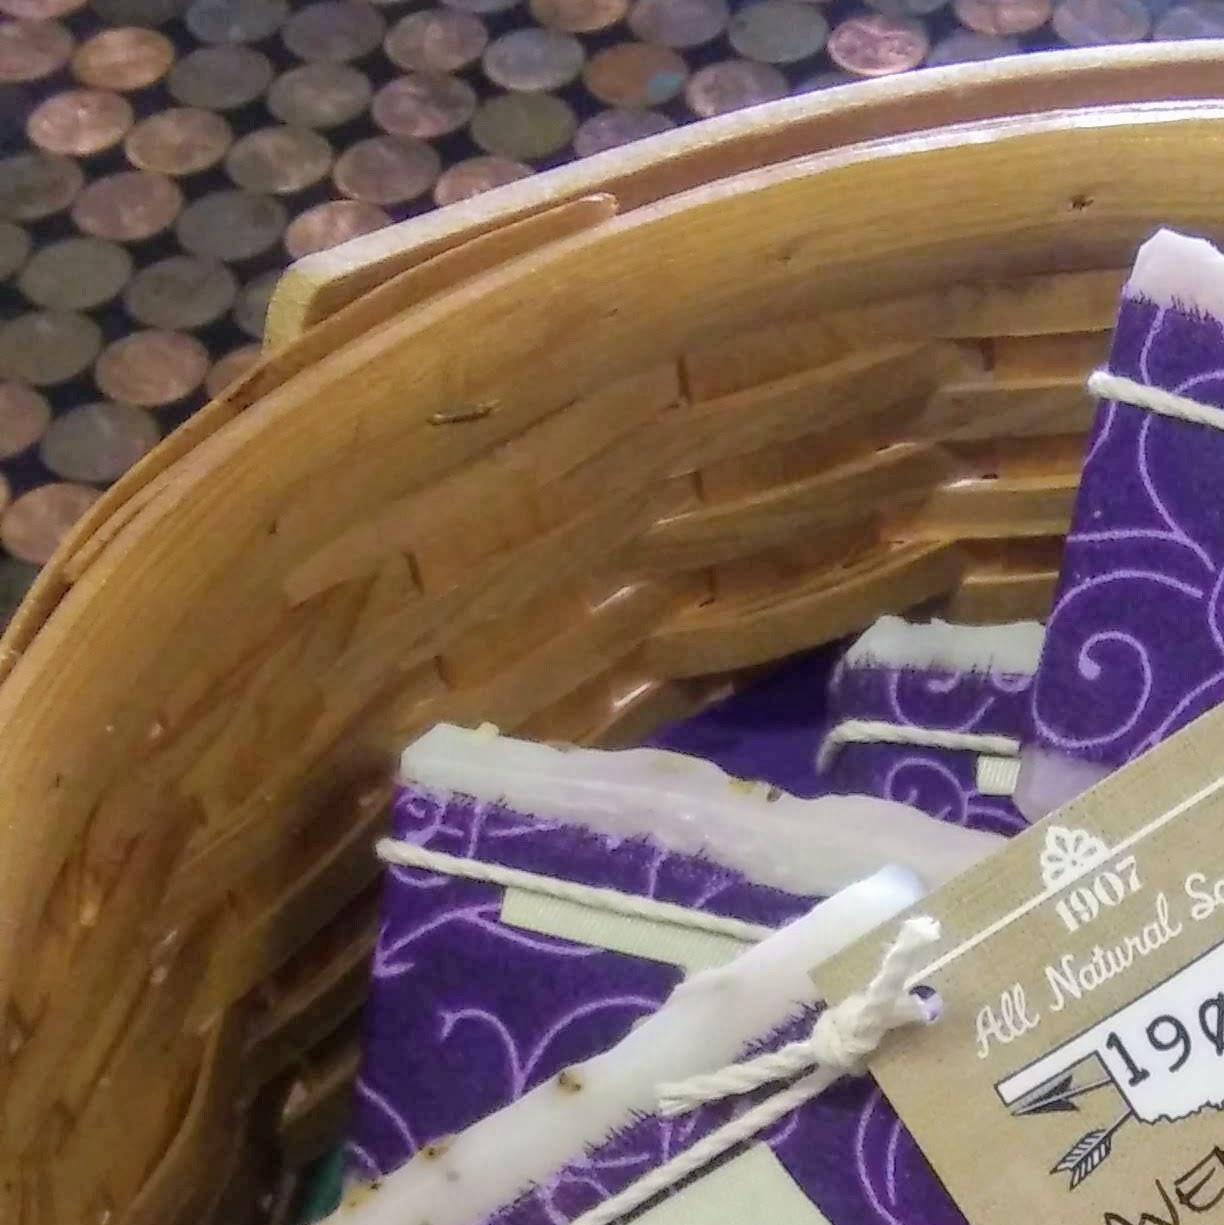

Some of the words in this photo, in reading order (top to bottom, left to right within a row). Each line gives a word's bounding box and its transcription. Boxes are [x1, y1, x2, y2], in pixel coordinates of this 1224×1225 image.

[1055, 855, 1144, 933] 1907
[975, 982, 1041, 1059] All
[1044, 891, 1183, 1012] Natural
